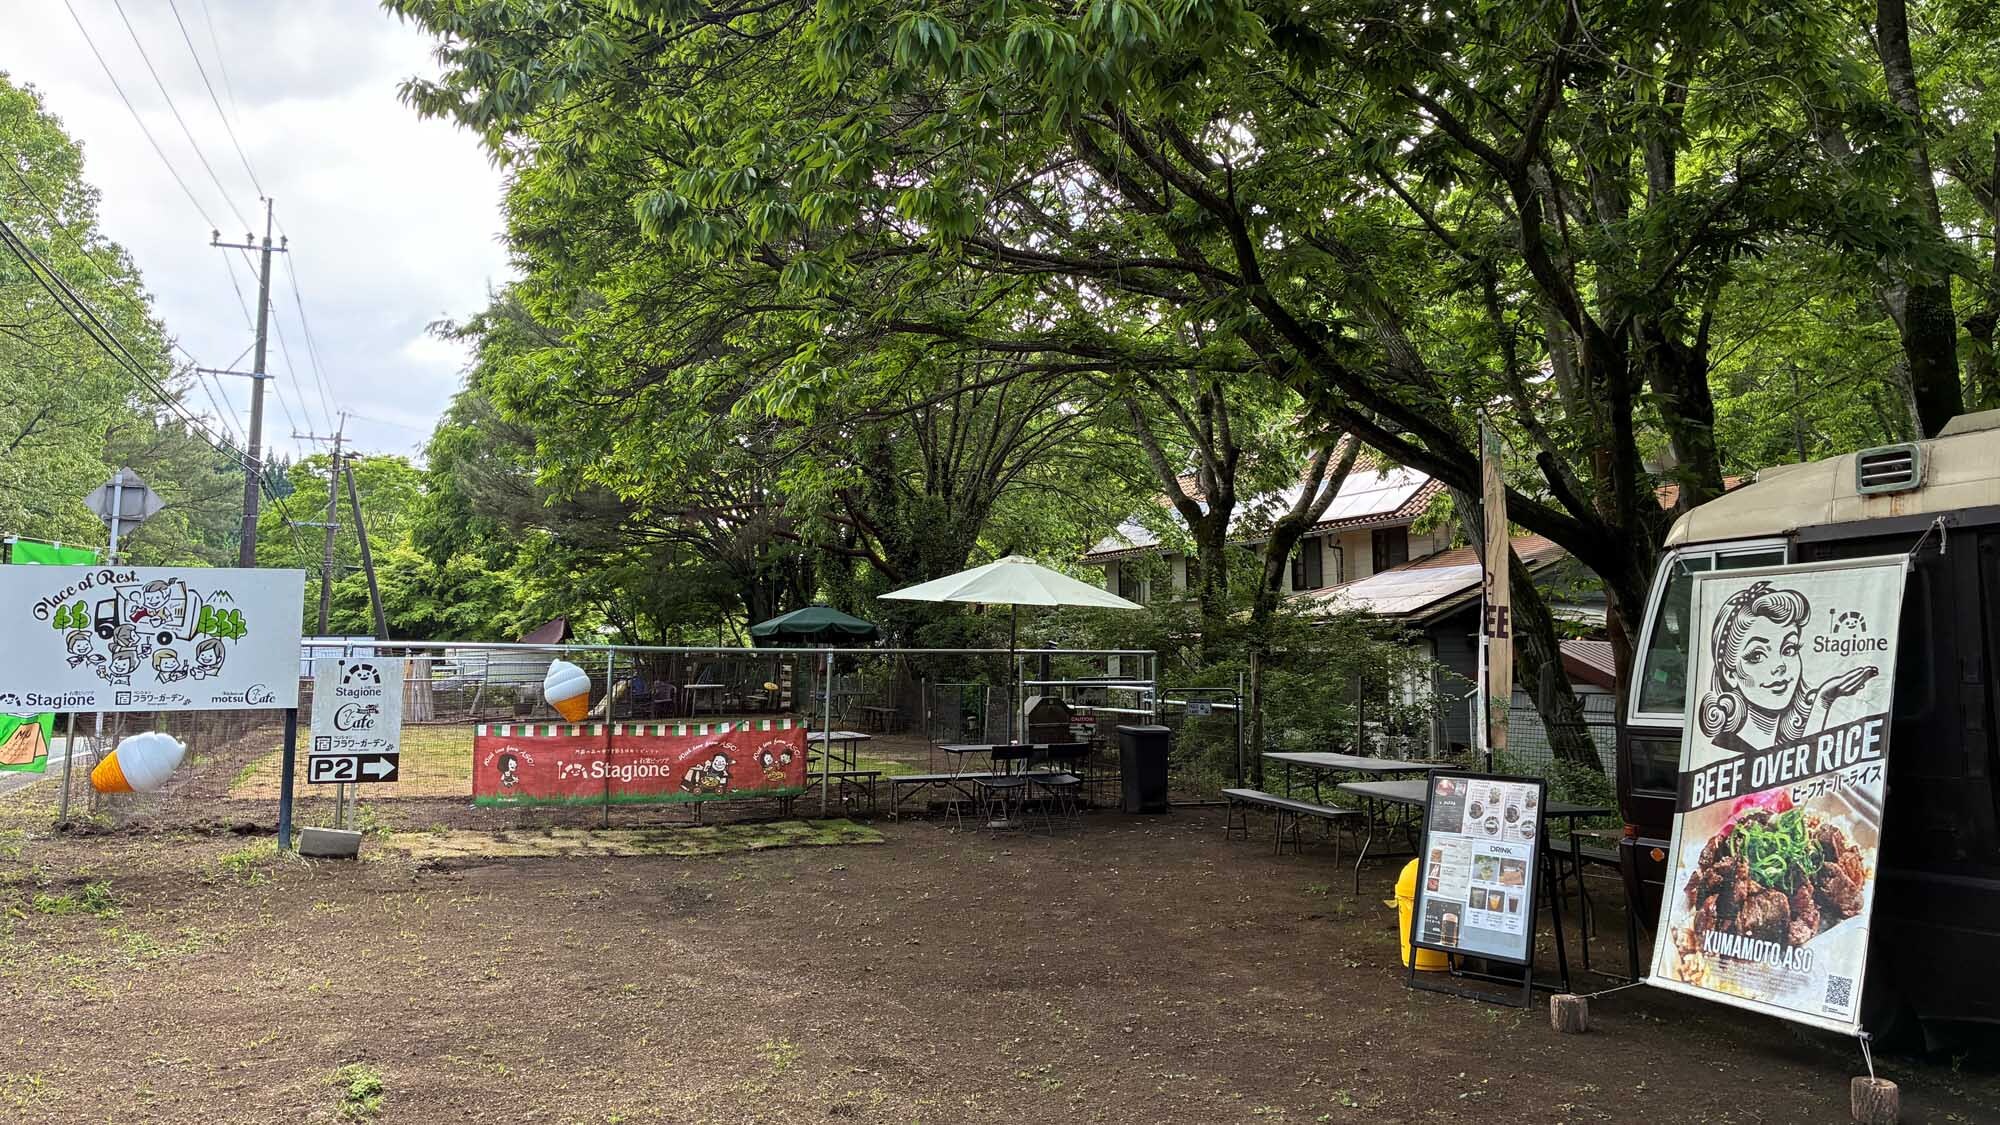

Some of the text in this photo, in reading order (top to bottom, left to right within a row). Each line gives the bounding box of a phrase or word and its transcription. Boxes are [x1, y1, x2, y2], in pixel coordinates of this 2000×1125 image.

[33, 569, 140, 620] Place of Rest.
[1813, 634, 1888, 656] Stagione
[26, 692, 95, 709] Stagione
[133, 694, 184, 702] フラワーガーデン
[336, 687, 381, 698] Stagione
[334, 703, 375, 731] Cafe
[333, 739, 386, 748] フラワーガーデン
[315, 759, 353, 779] P2
[591, 760, 670, 782] Stagione
[1691, 719, 1883, 808] BEEF OVER RICE
[1490, 845, 1512, 854] DRINK
